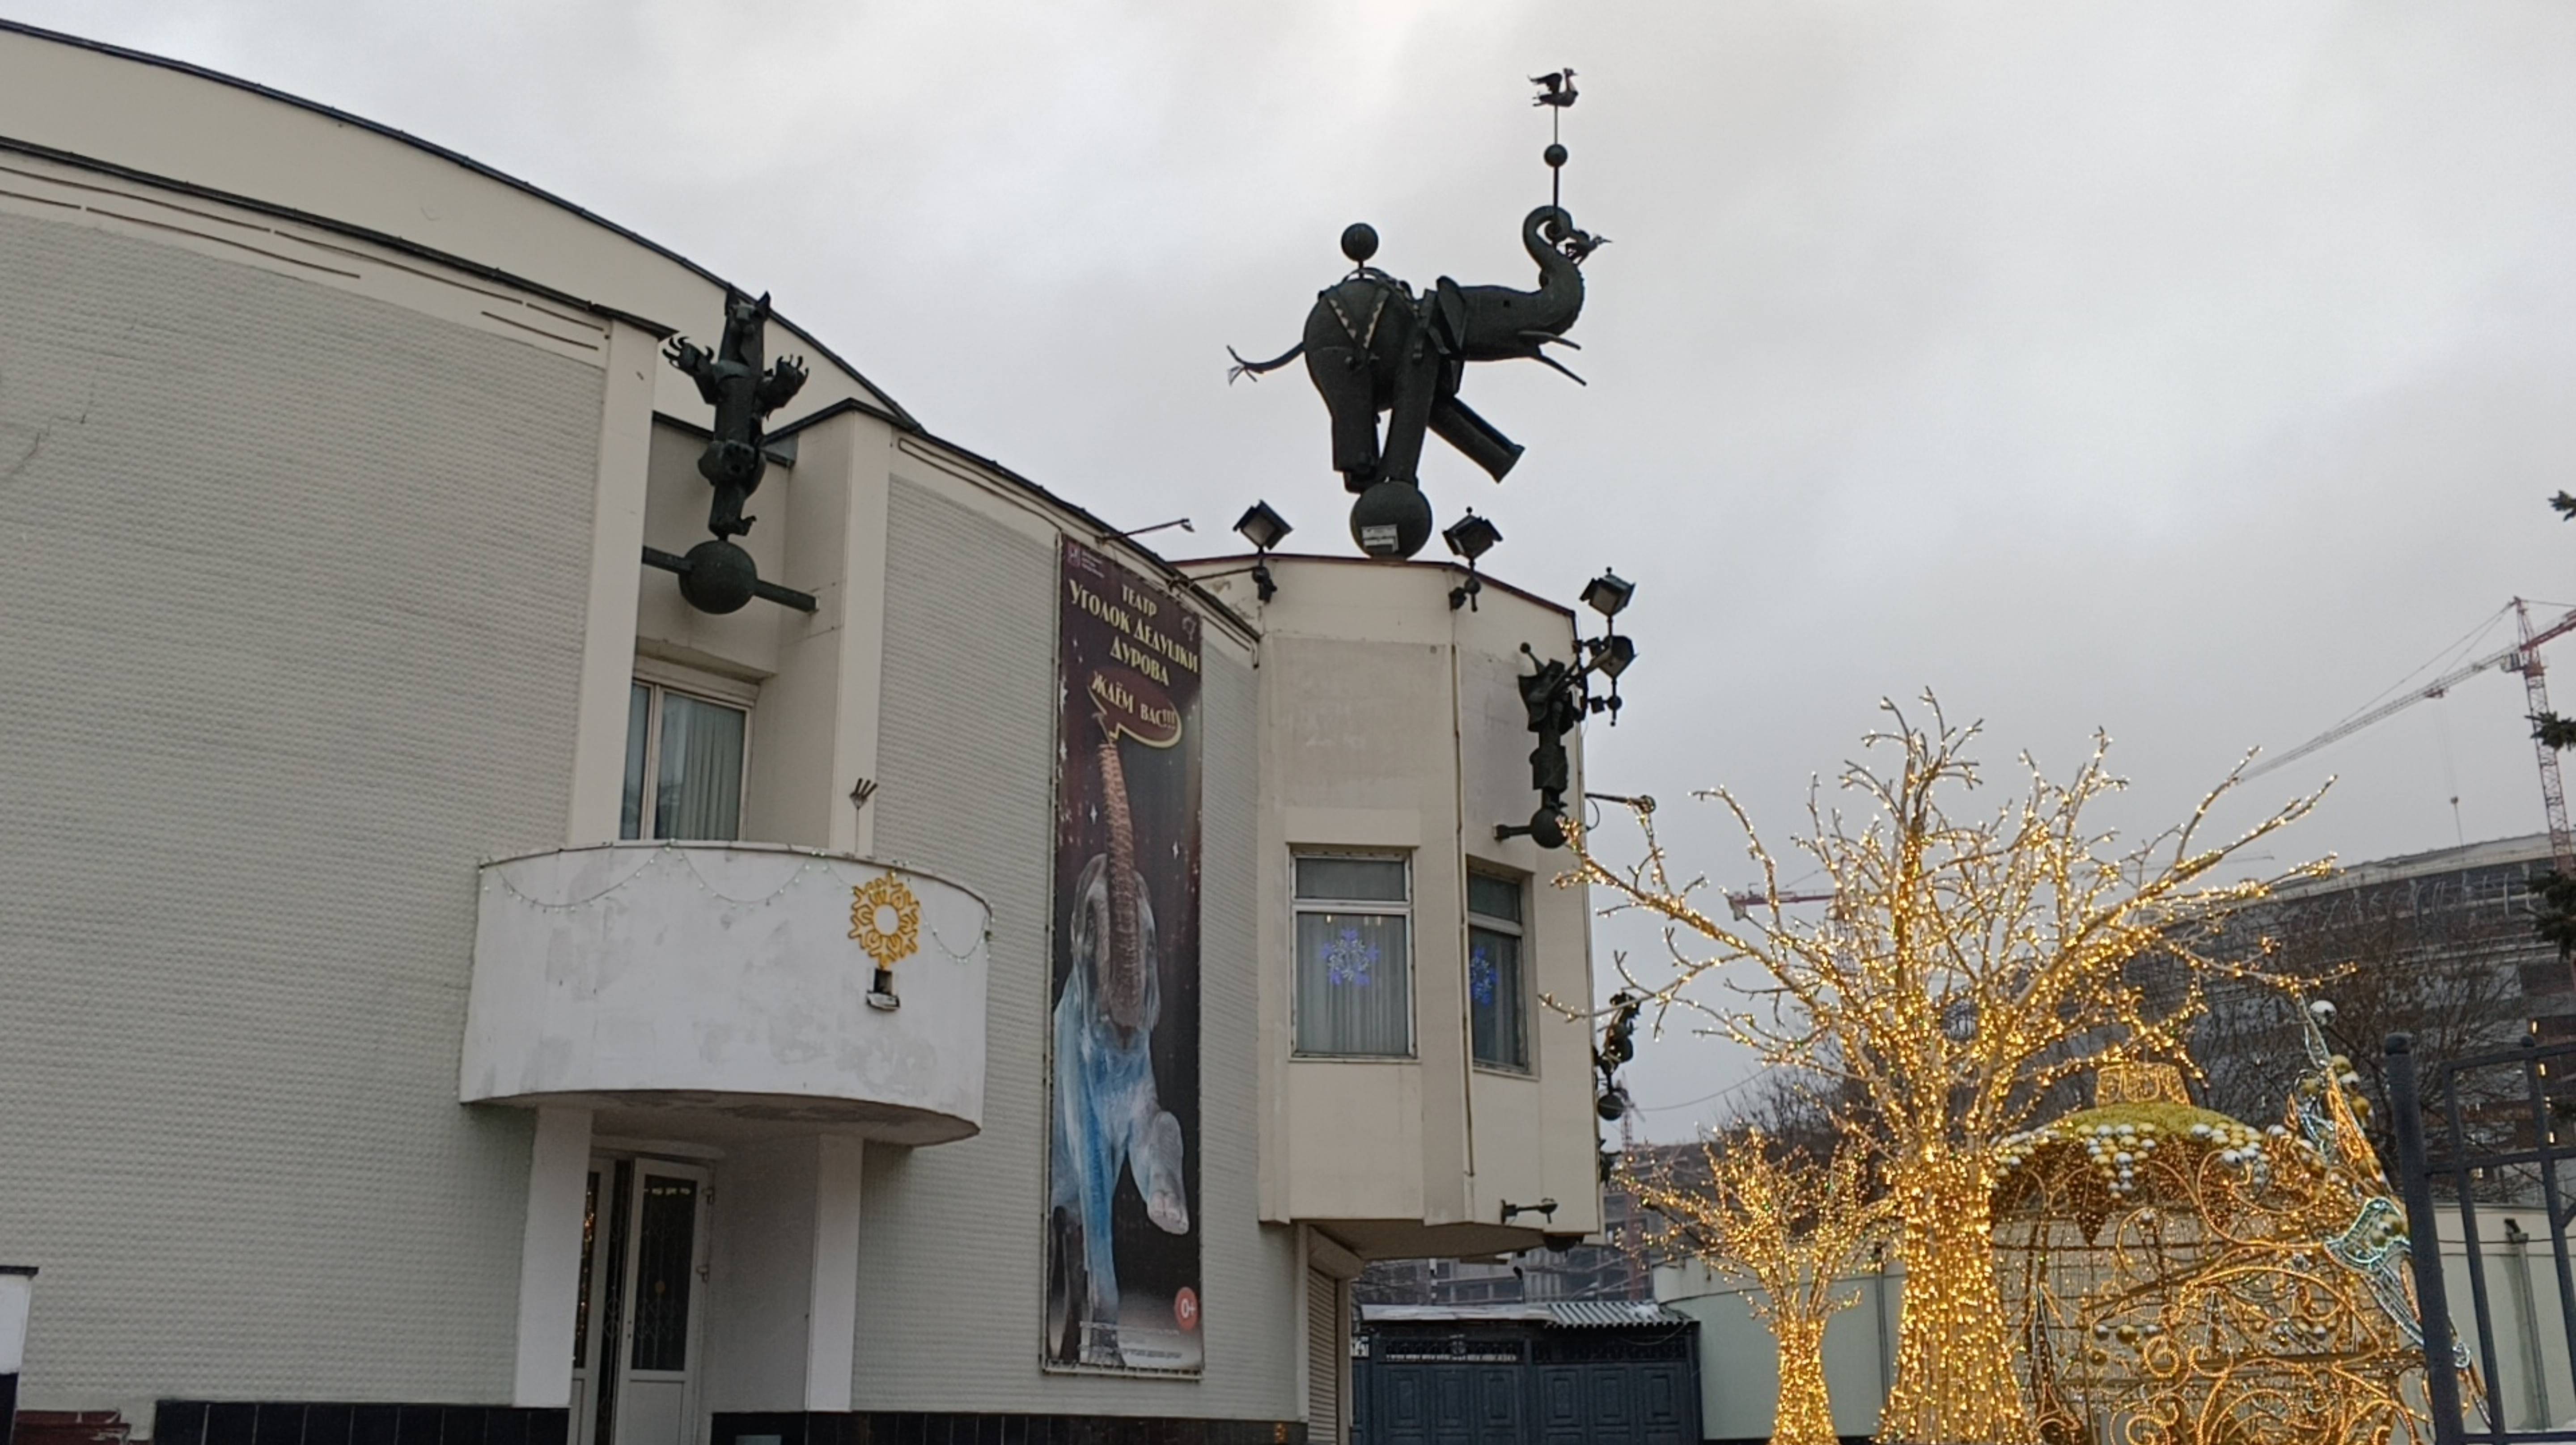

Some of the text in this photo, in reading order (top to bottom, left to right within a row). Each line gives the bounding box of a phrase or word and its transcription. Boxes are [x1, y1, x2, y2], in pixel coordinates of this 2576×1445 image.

[1122, 584, 1157, 617] ТЕАТР
[1069, 579, 1198, 673] УГОЛОК ДЕДУШКИ
[1110, 636, 1169, 686] ДУРОВА
[1092, 670, 1133, 713] ЖДЁМ
[1181, 1298, 1196, 1319] 0+
